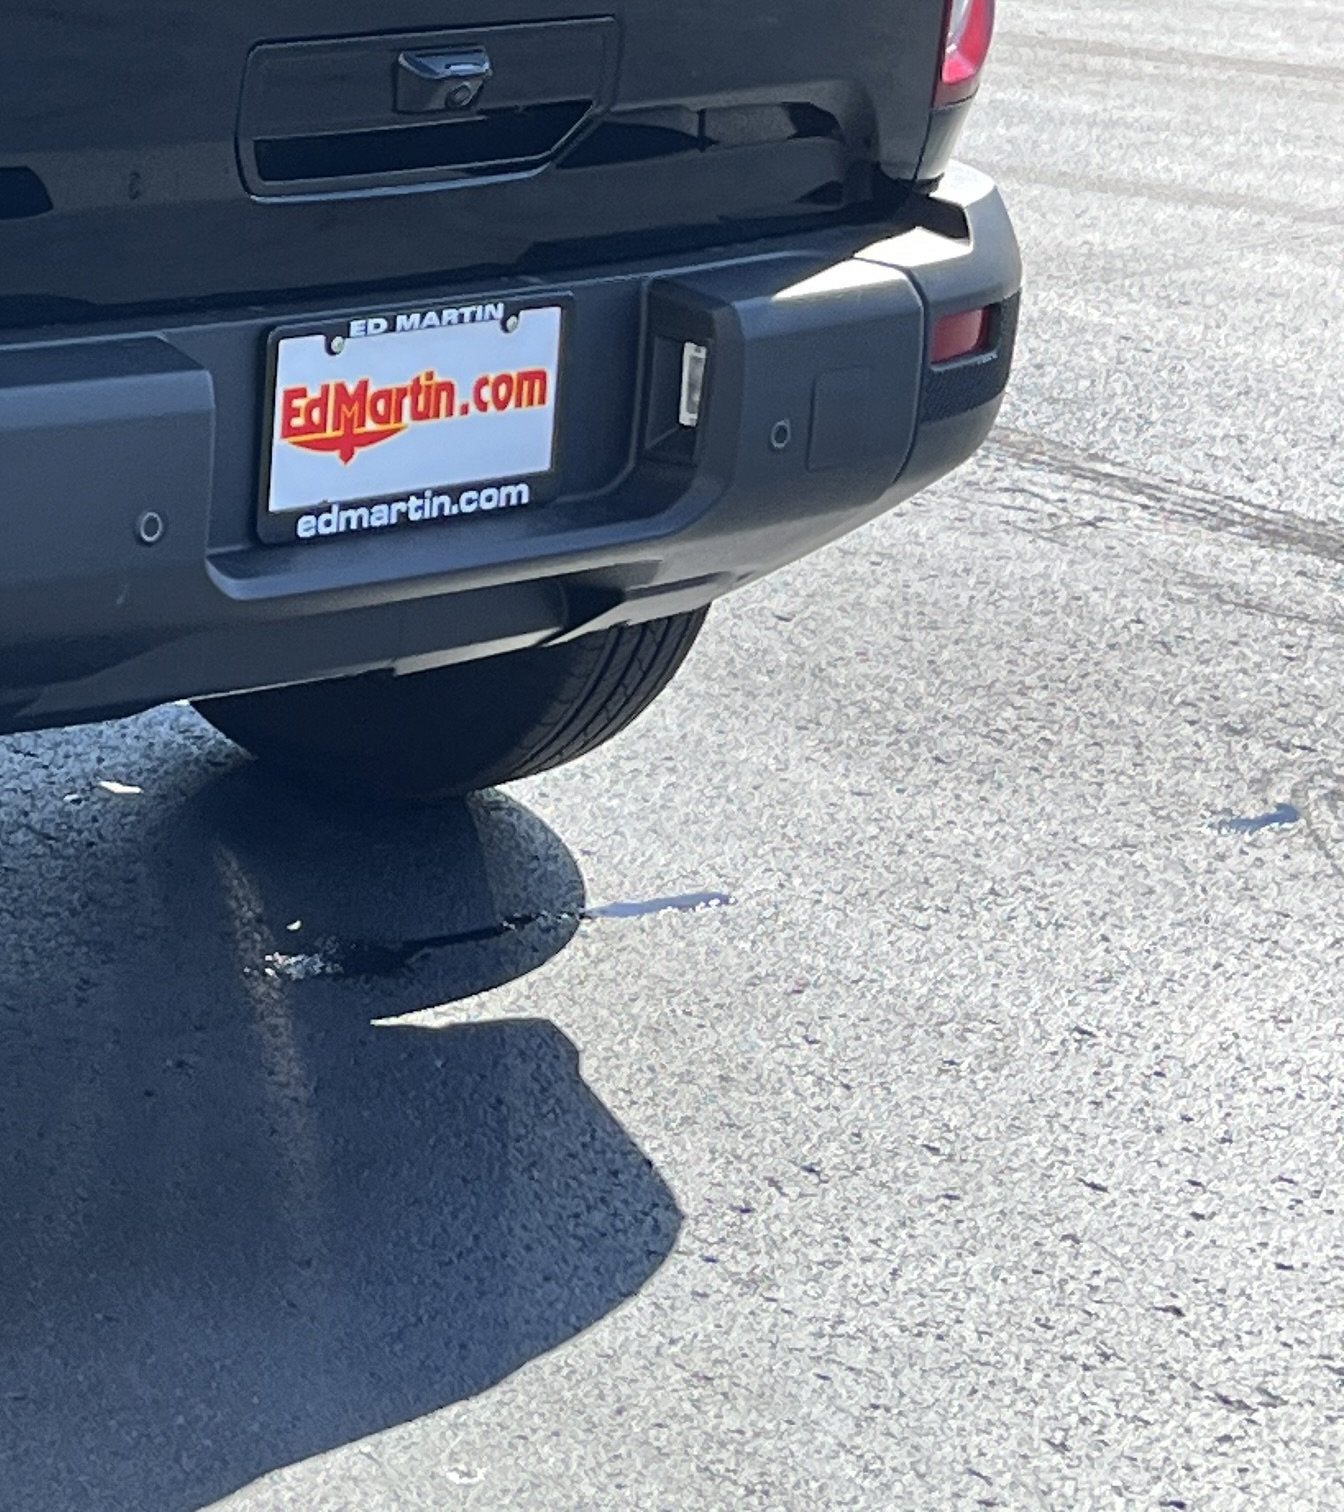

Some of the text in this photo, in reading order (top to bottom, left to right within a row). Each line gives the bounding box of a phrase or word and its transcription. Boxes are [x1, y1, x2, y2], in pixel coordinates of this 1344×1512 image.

[349, 302, 505, 338] ED MARTIN
[296, 482, 530, 538] edmartin.com
